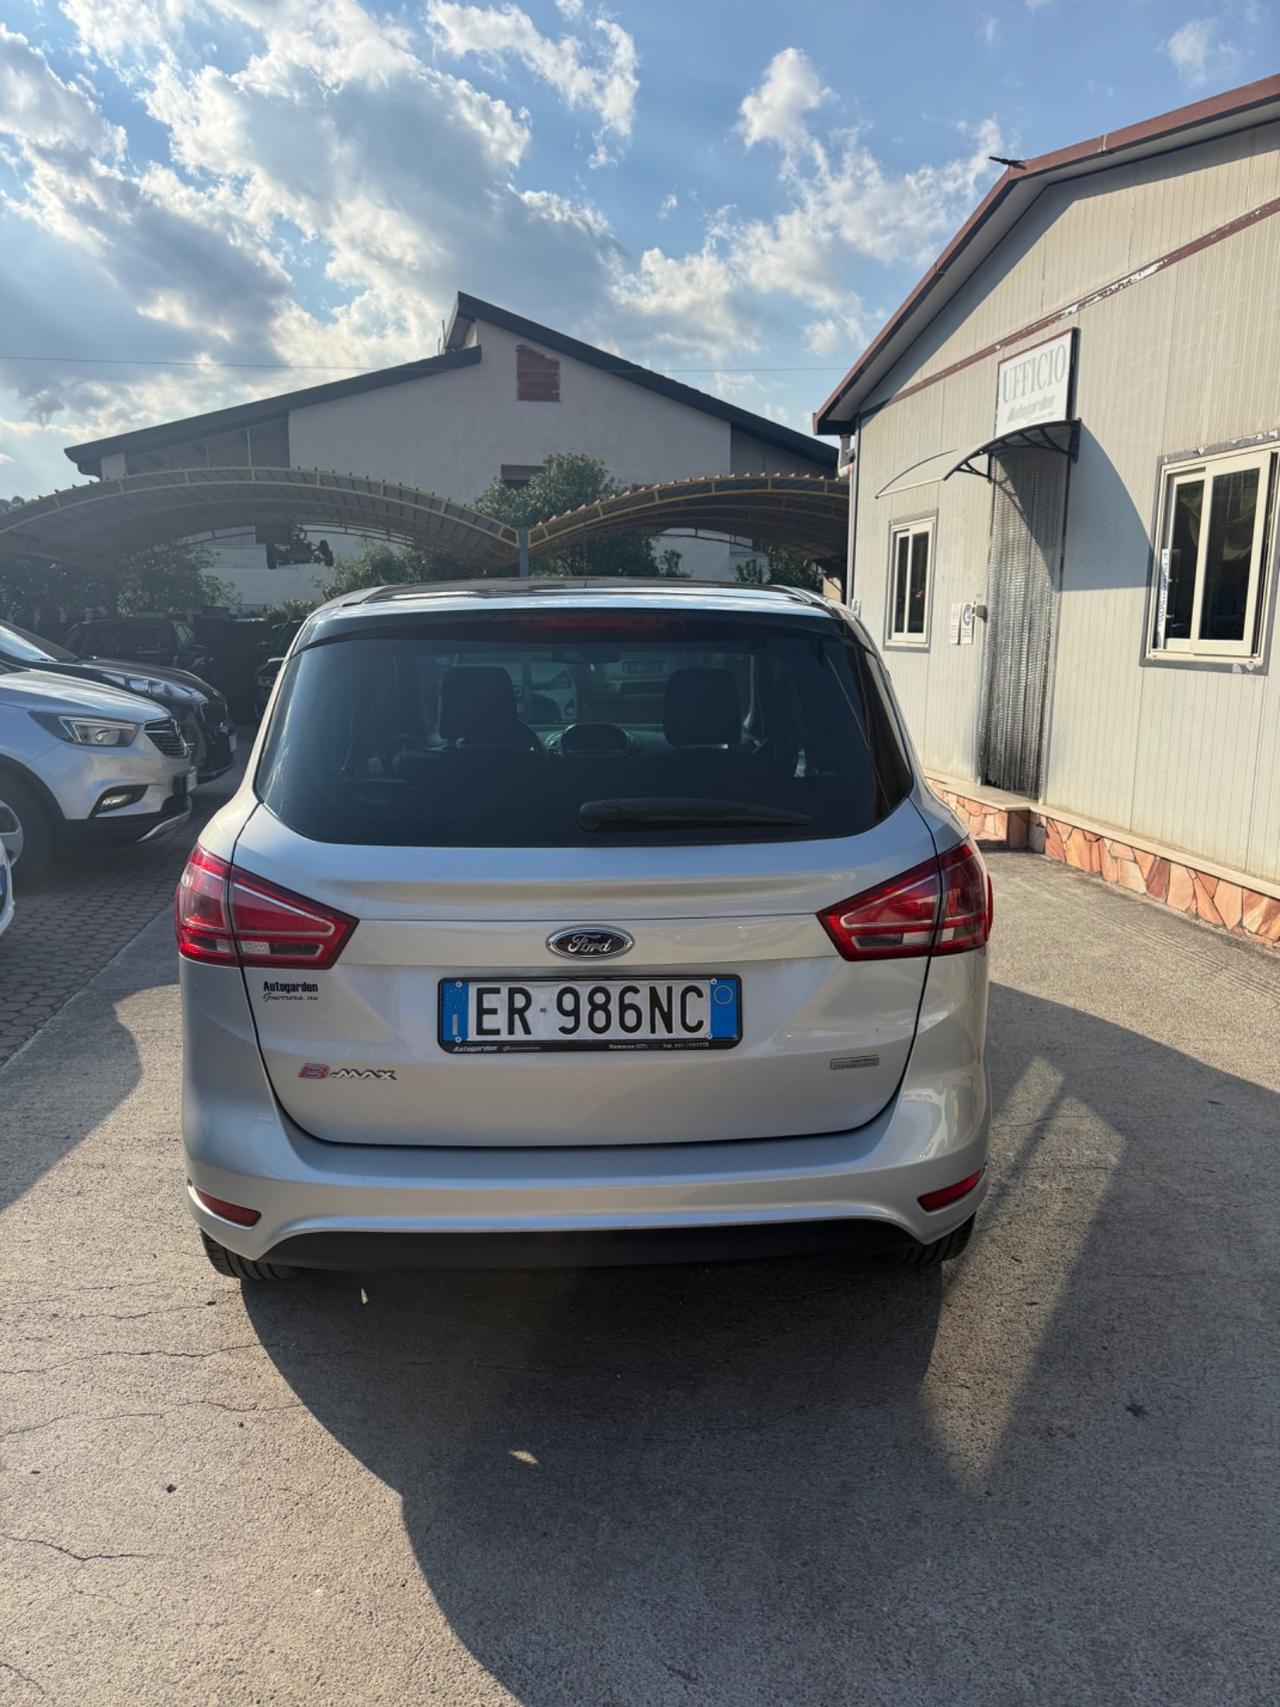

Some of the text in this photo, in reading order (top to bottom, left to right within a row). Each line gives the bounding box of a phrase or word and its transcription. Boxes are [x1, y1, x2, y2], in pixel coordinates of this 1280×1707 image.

[1002, 344, 1066, 403] UFFICIO
[567, 933, 612, 953] Ford
[263, 981, 318, 993] Autogarden
[476, 985, 704, 1036] ER 986NC
[297, 1062, 397, 1080] B-MAX
